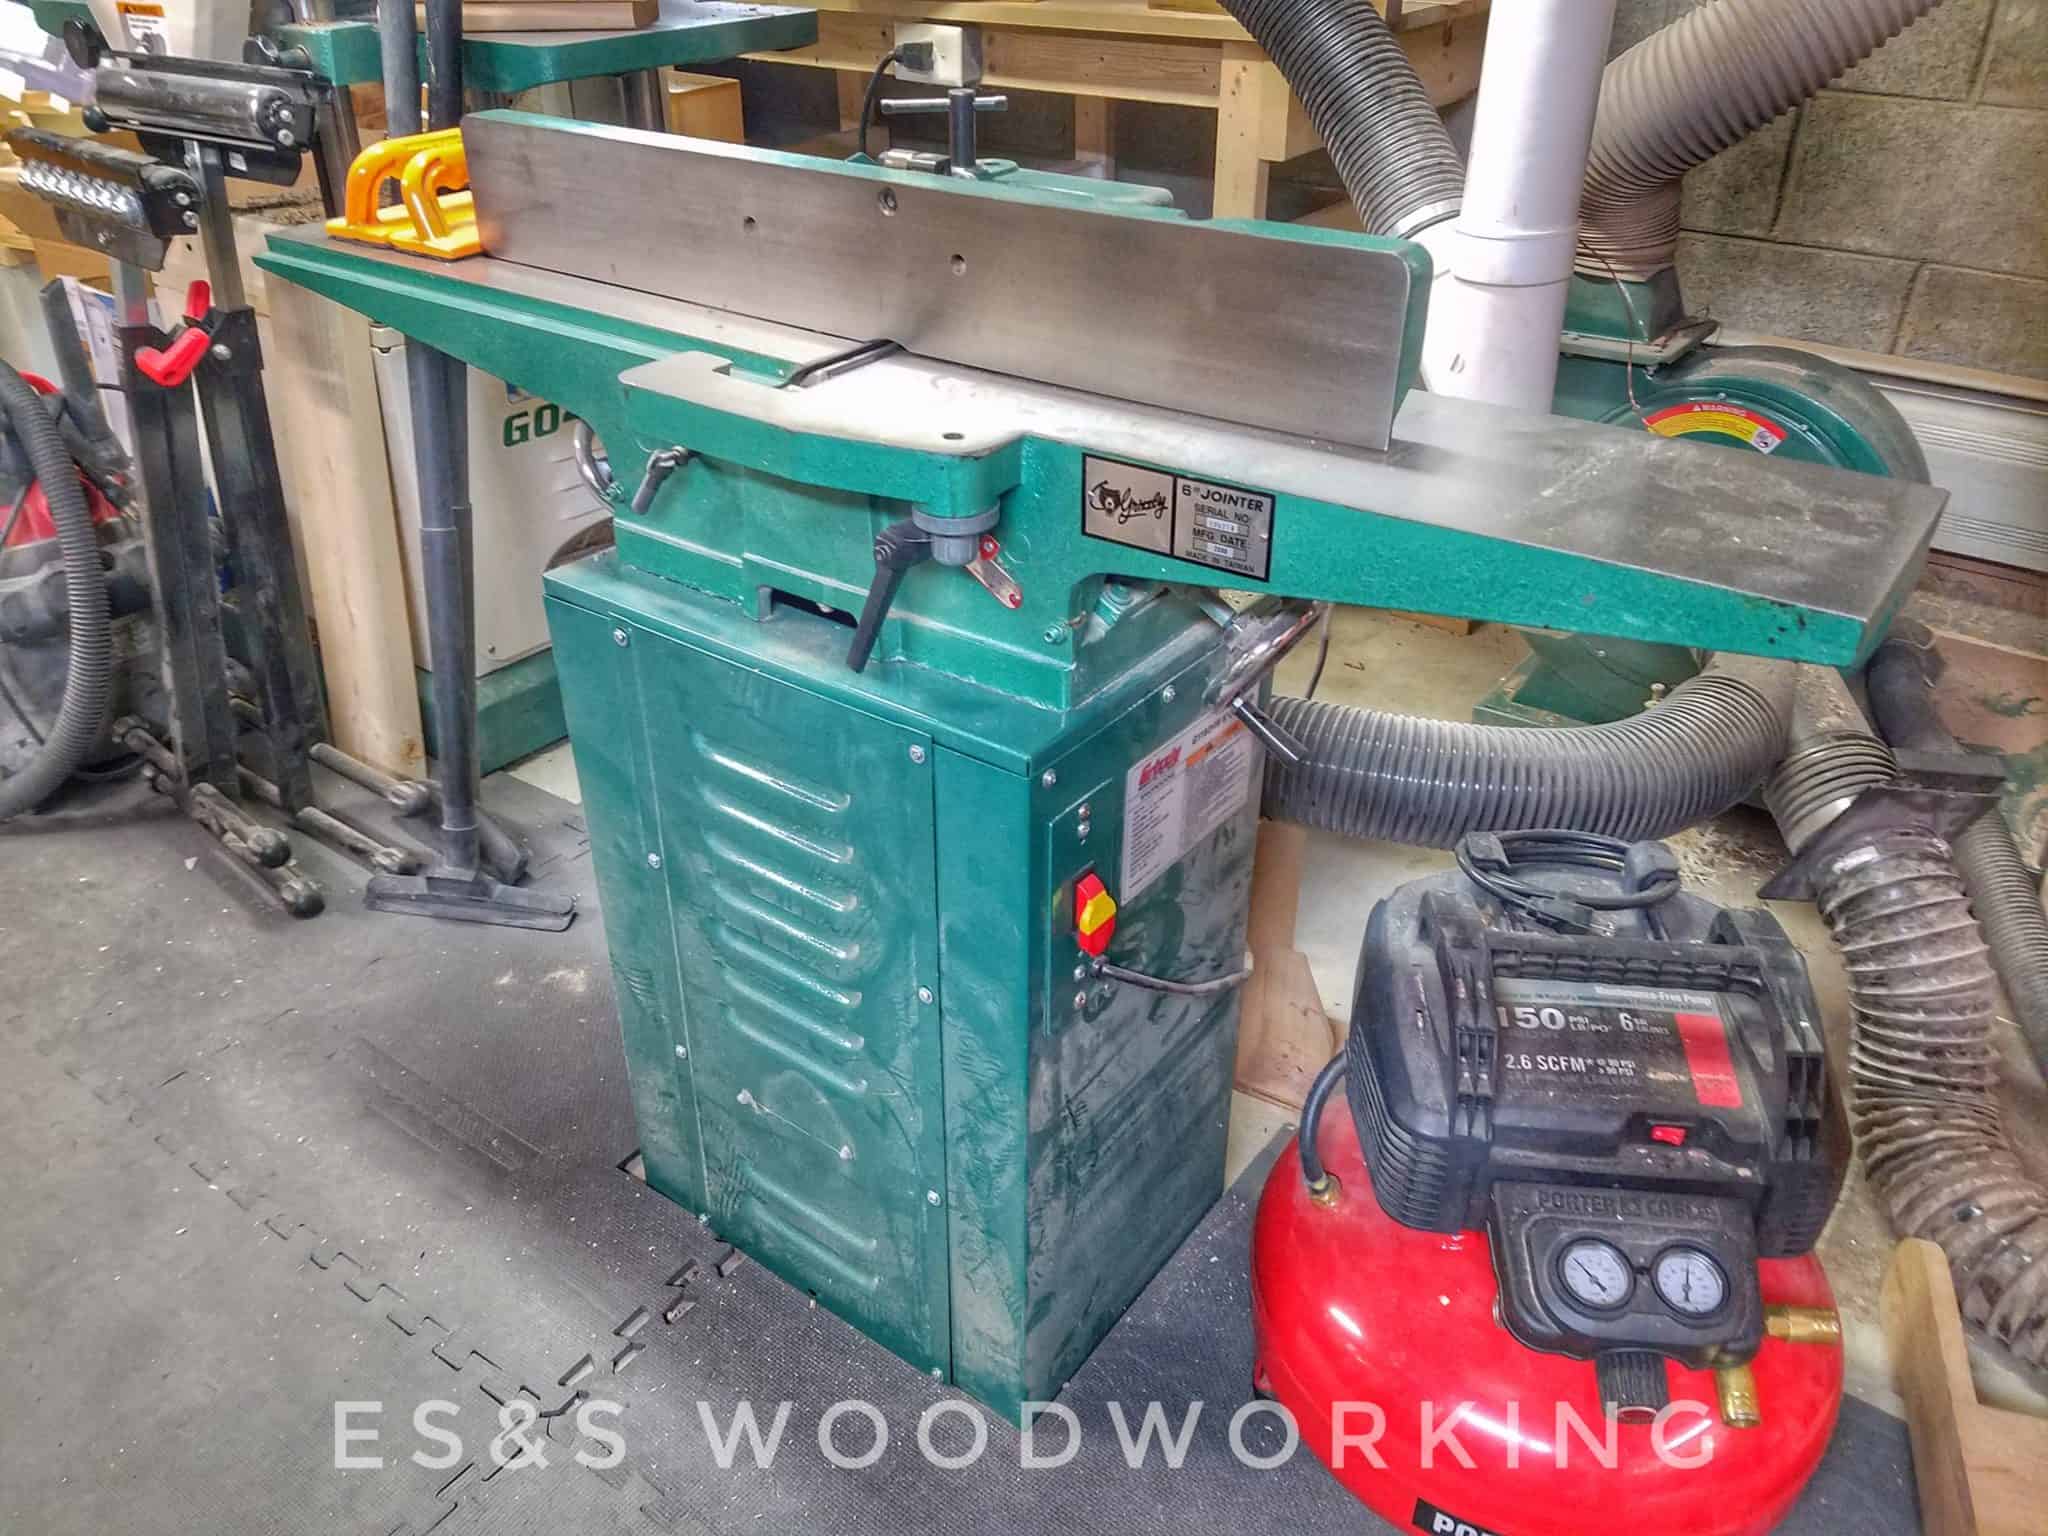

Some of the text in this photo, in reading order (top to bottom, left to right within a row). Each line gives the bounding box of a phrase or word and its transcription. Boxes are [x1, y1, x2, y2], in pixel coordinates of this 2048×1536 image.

[1201, 489, 1264, 512] JOINTER
[1194, 503, 1229, 519] SERIAL
[1219, 534, 1247, 548] DATE
[1495, 1005, 1566, 1031] 150
[1619, 1012, 1635, 1032] 6
[1504, 1053, 1532, 1070] 2.6
